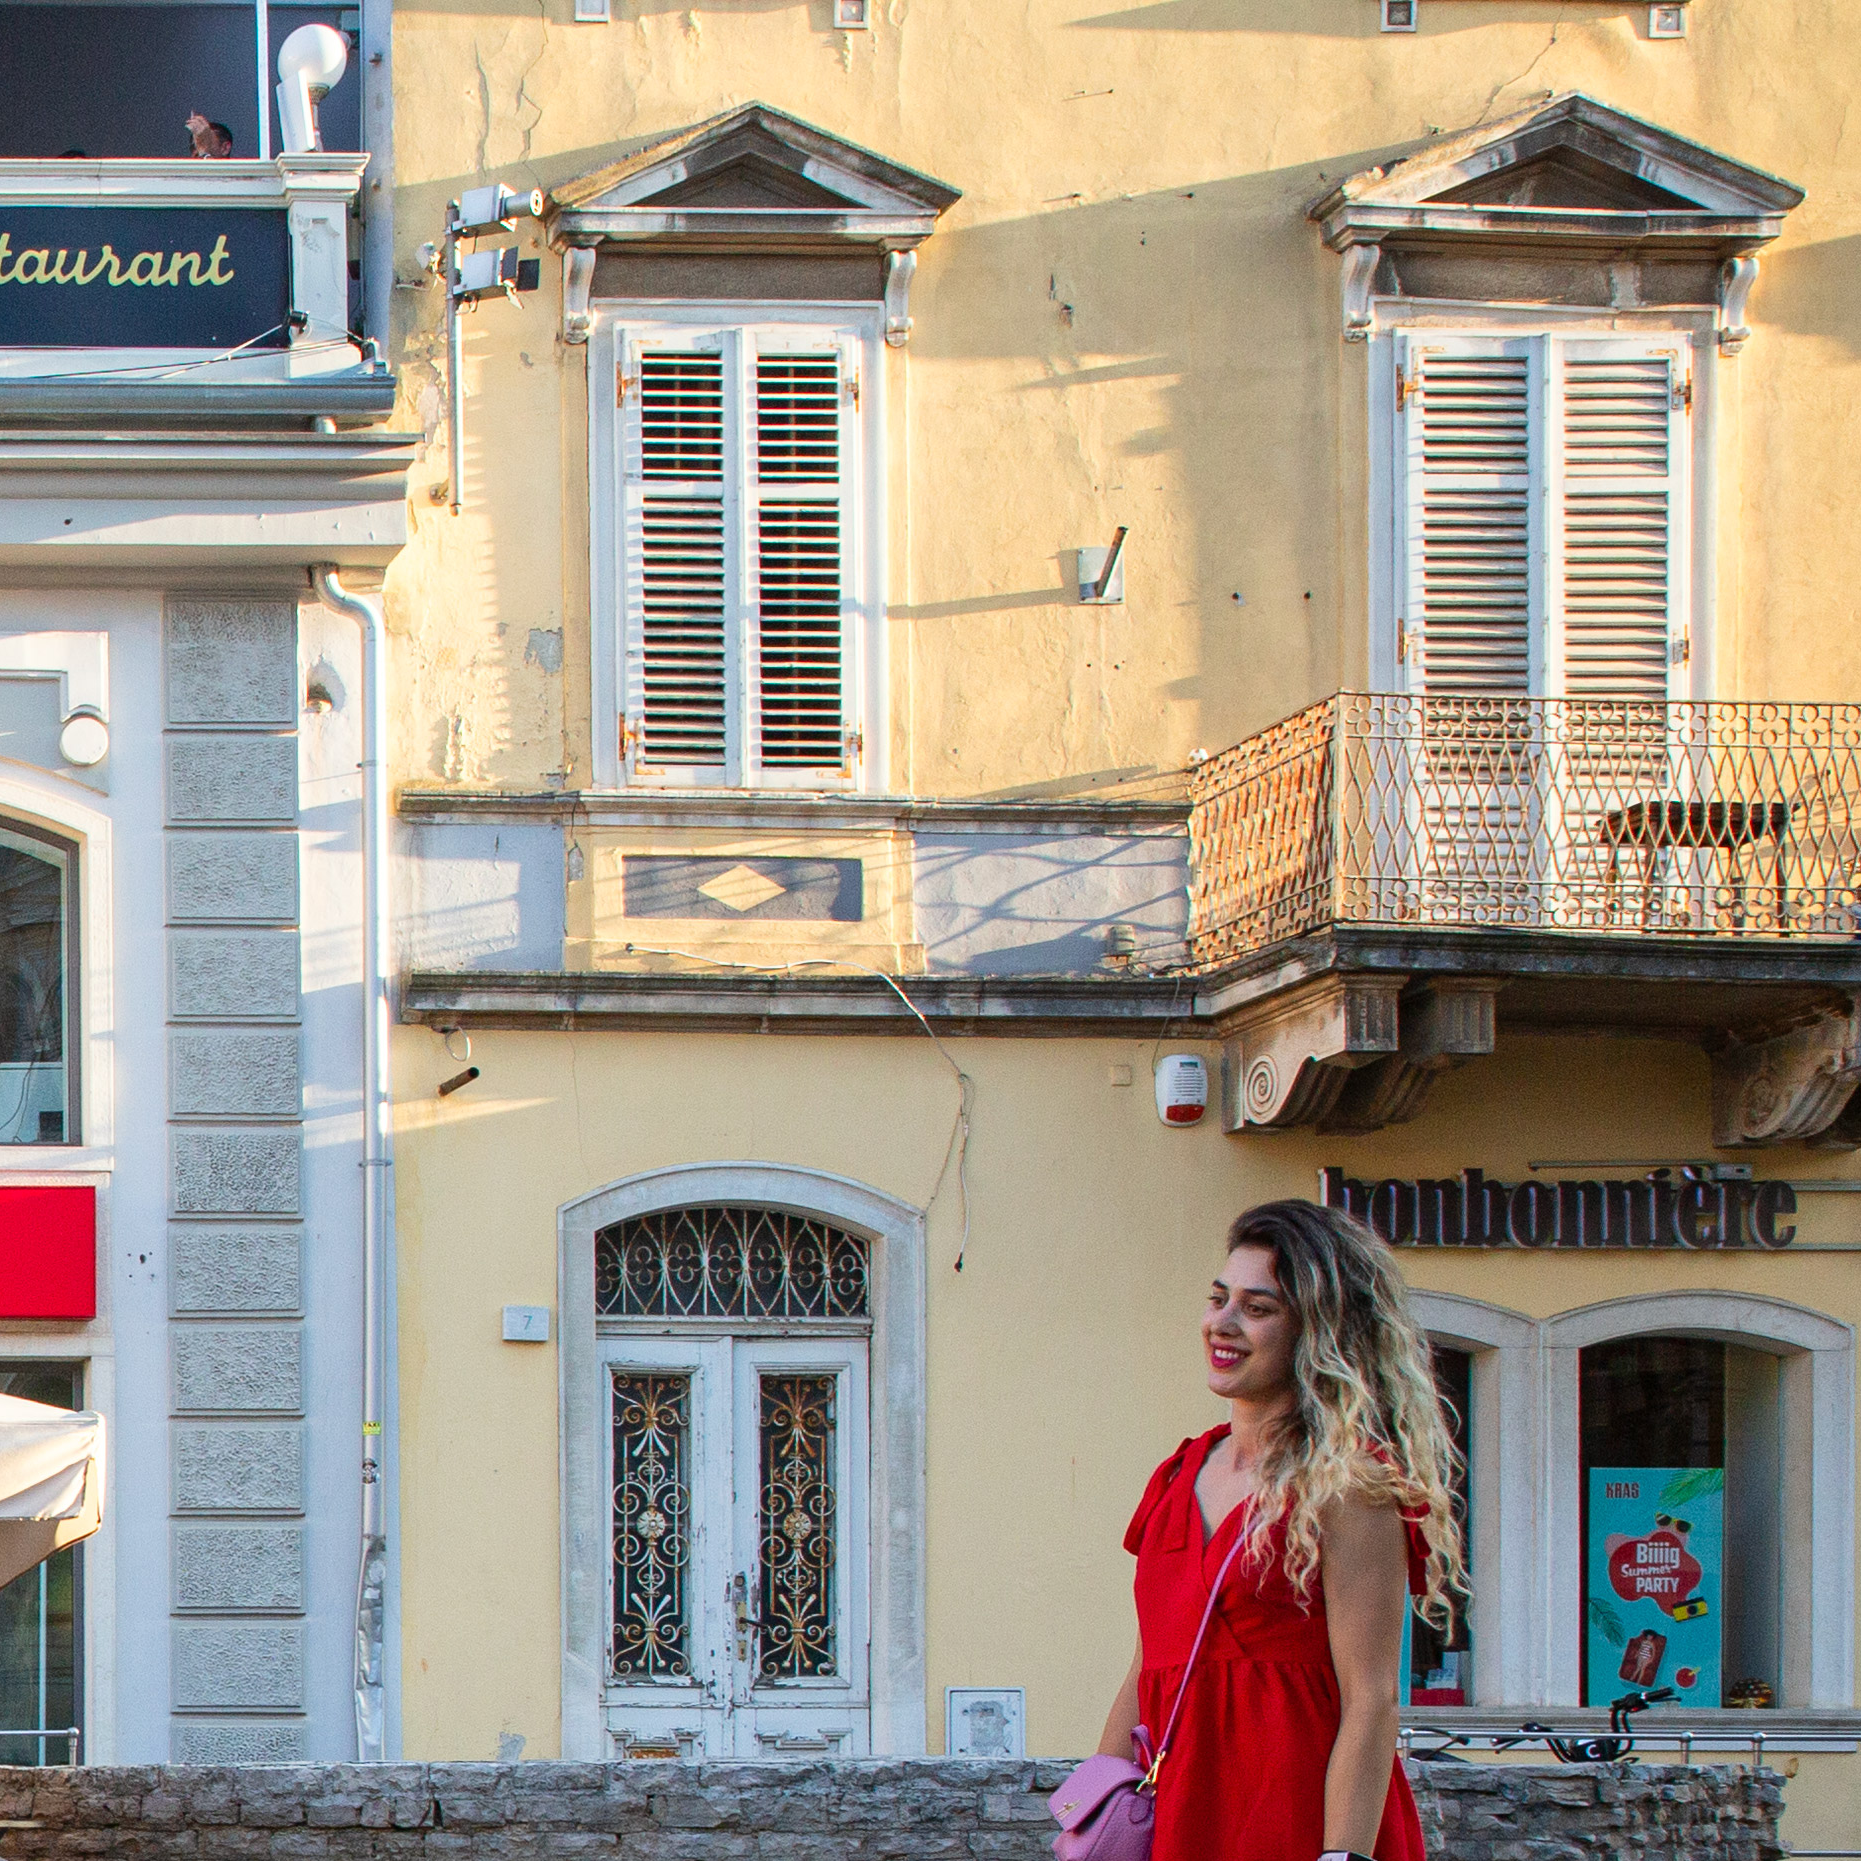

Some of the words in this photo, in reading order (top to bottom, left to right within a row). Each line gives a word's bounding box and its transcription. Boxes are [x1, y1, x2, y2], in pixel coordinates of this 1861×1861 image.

[523, 1314, 533, 1330] 7
[1621, 1563, 1672, 1578] Summer
[1636, 1577, 1680, 1593] PARTY
